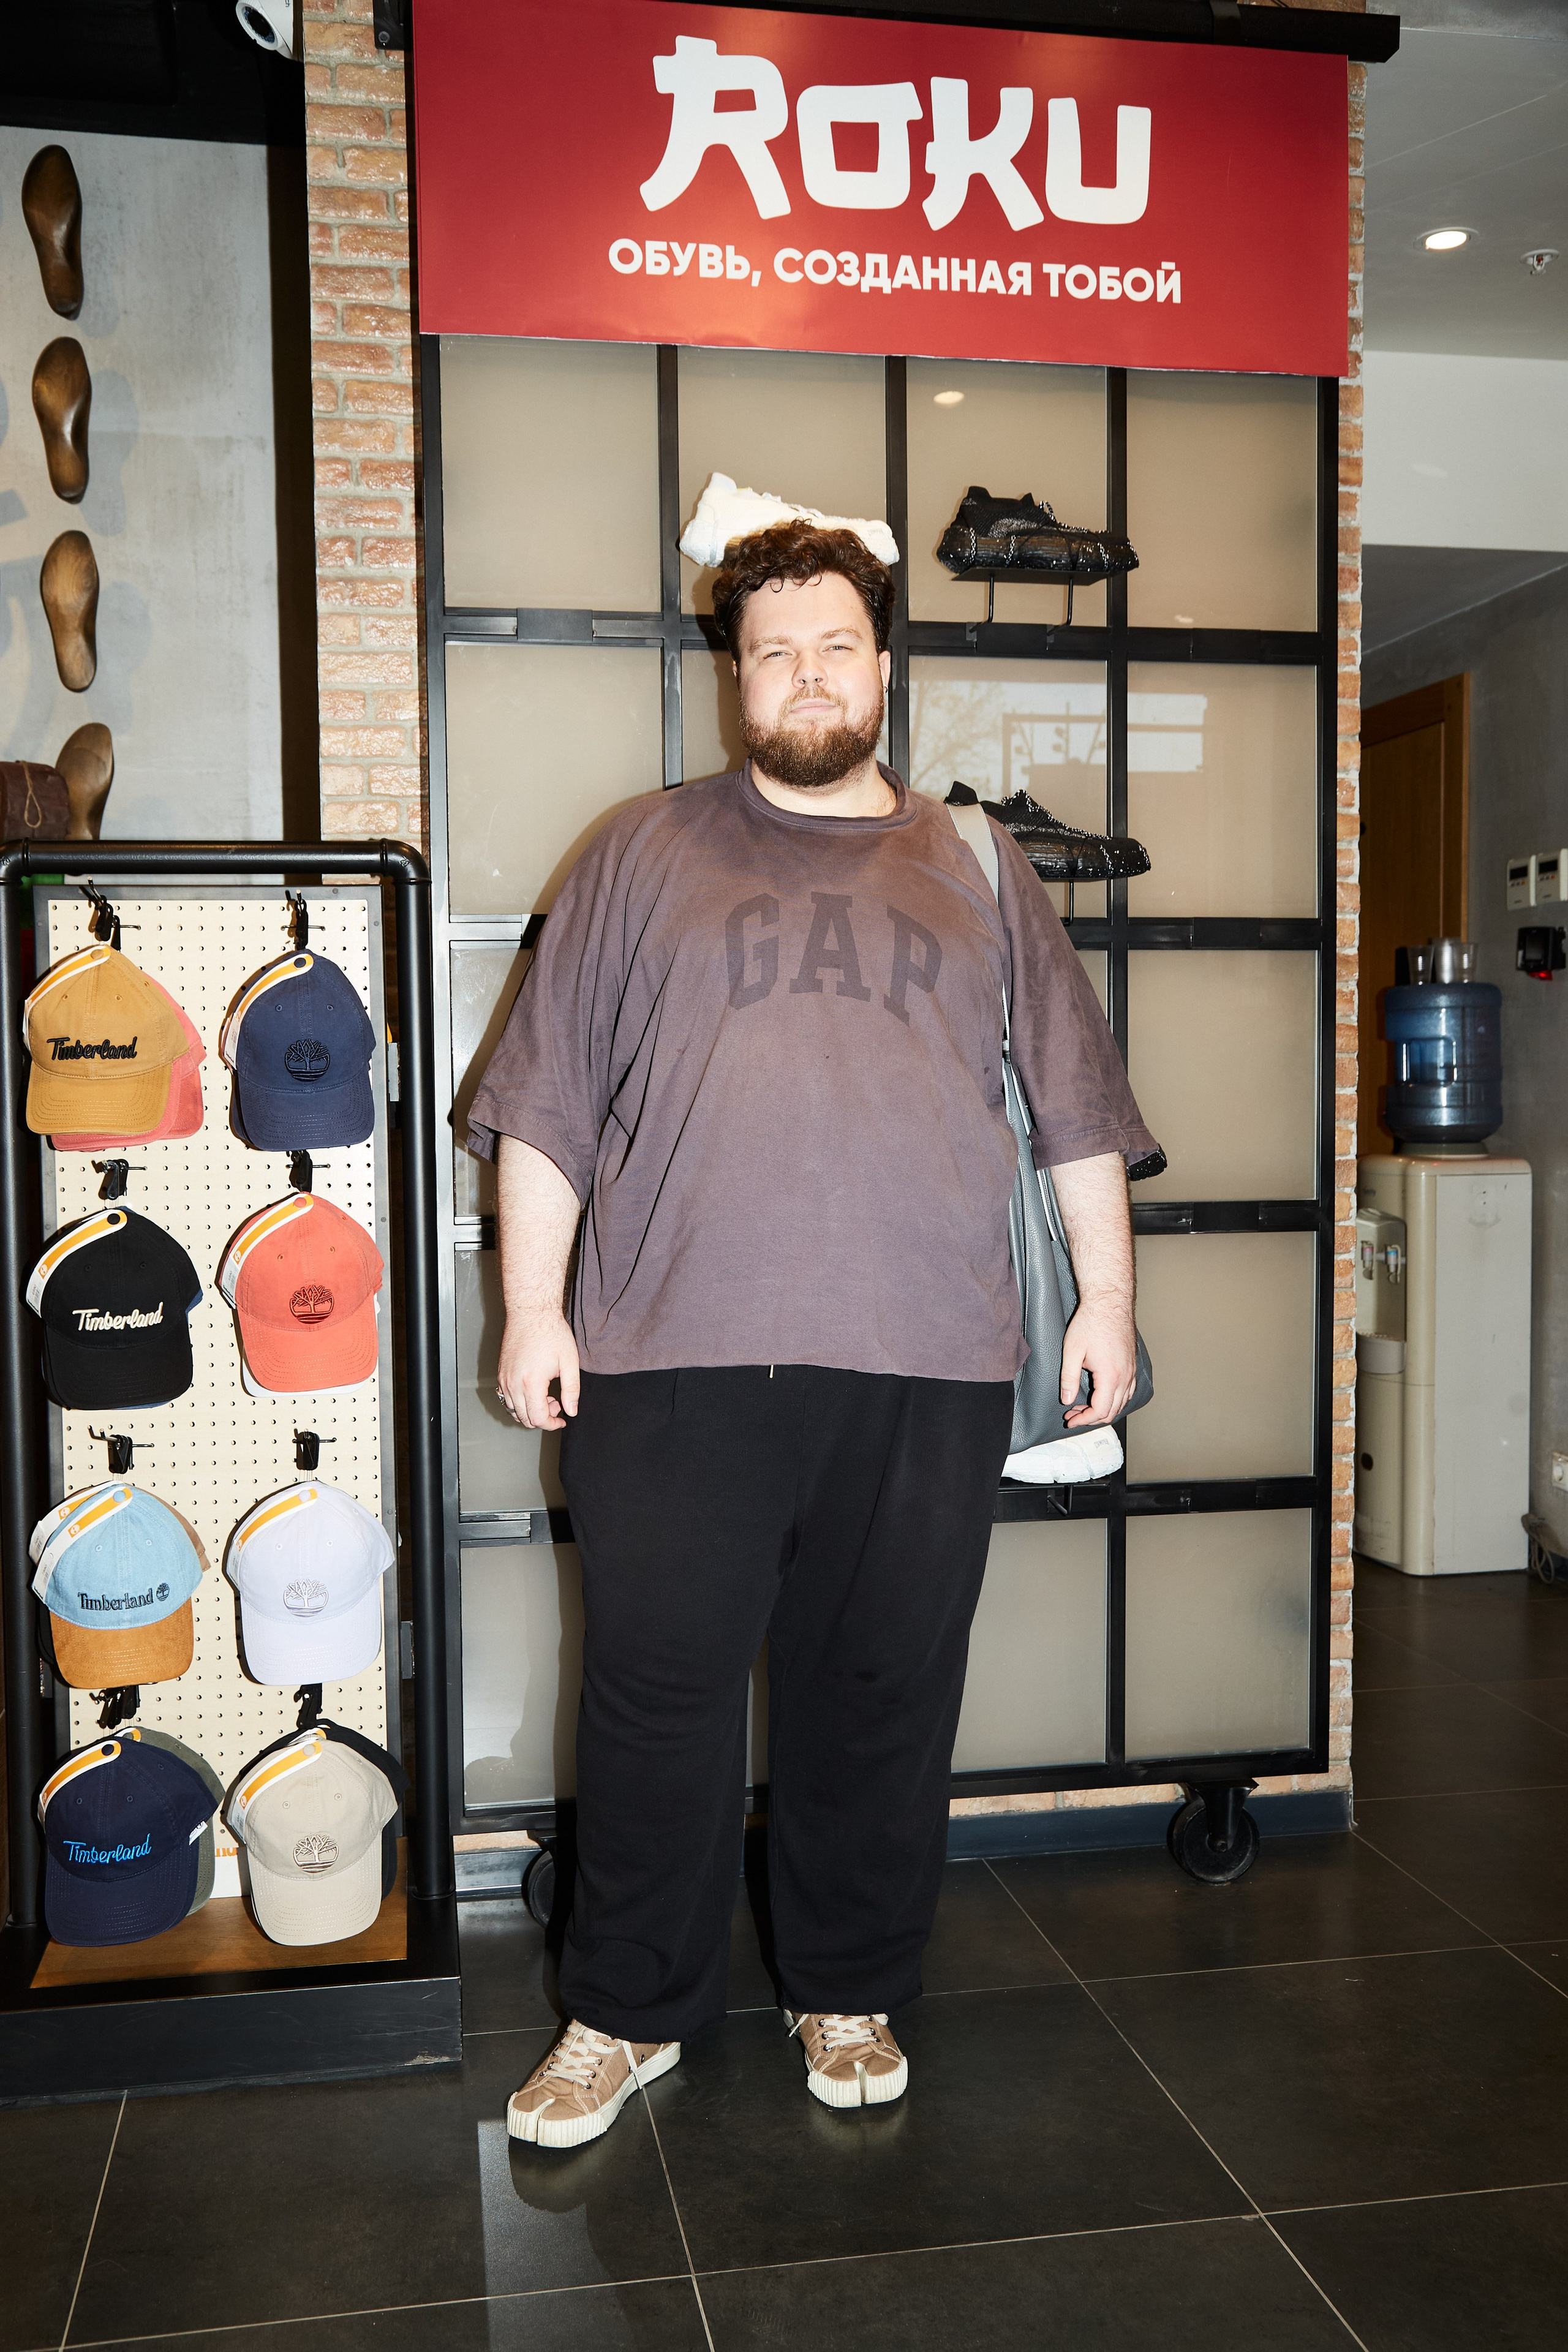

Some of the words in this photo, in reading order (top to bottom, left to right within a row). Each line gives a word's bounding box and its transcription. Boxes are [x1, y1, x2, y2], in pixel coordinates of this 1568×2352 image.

[640, 36, 1152, 232] ROKU
[608, 238, 762, 287] ОБУВЬ,
[773, 247, 1032, 296] СОЗДАННАЯ
[1042, 261, 1181, 304] ТОБОЙ
[725, 891, 943, 1027] GAP
[47, 1036, 138, 1060] Timberland
[72, 1302, 164, 1331] Timberland
[77, 1588, 154, 1611] Timberland
[63, 1833, 152, 1864] Timberland
